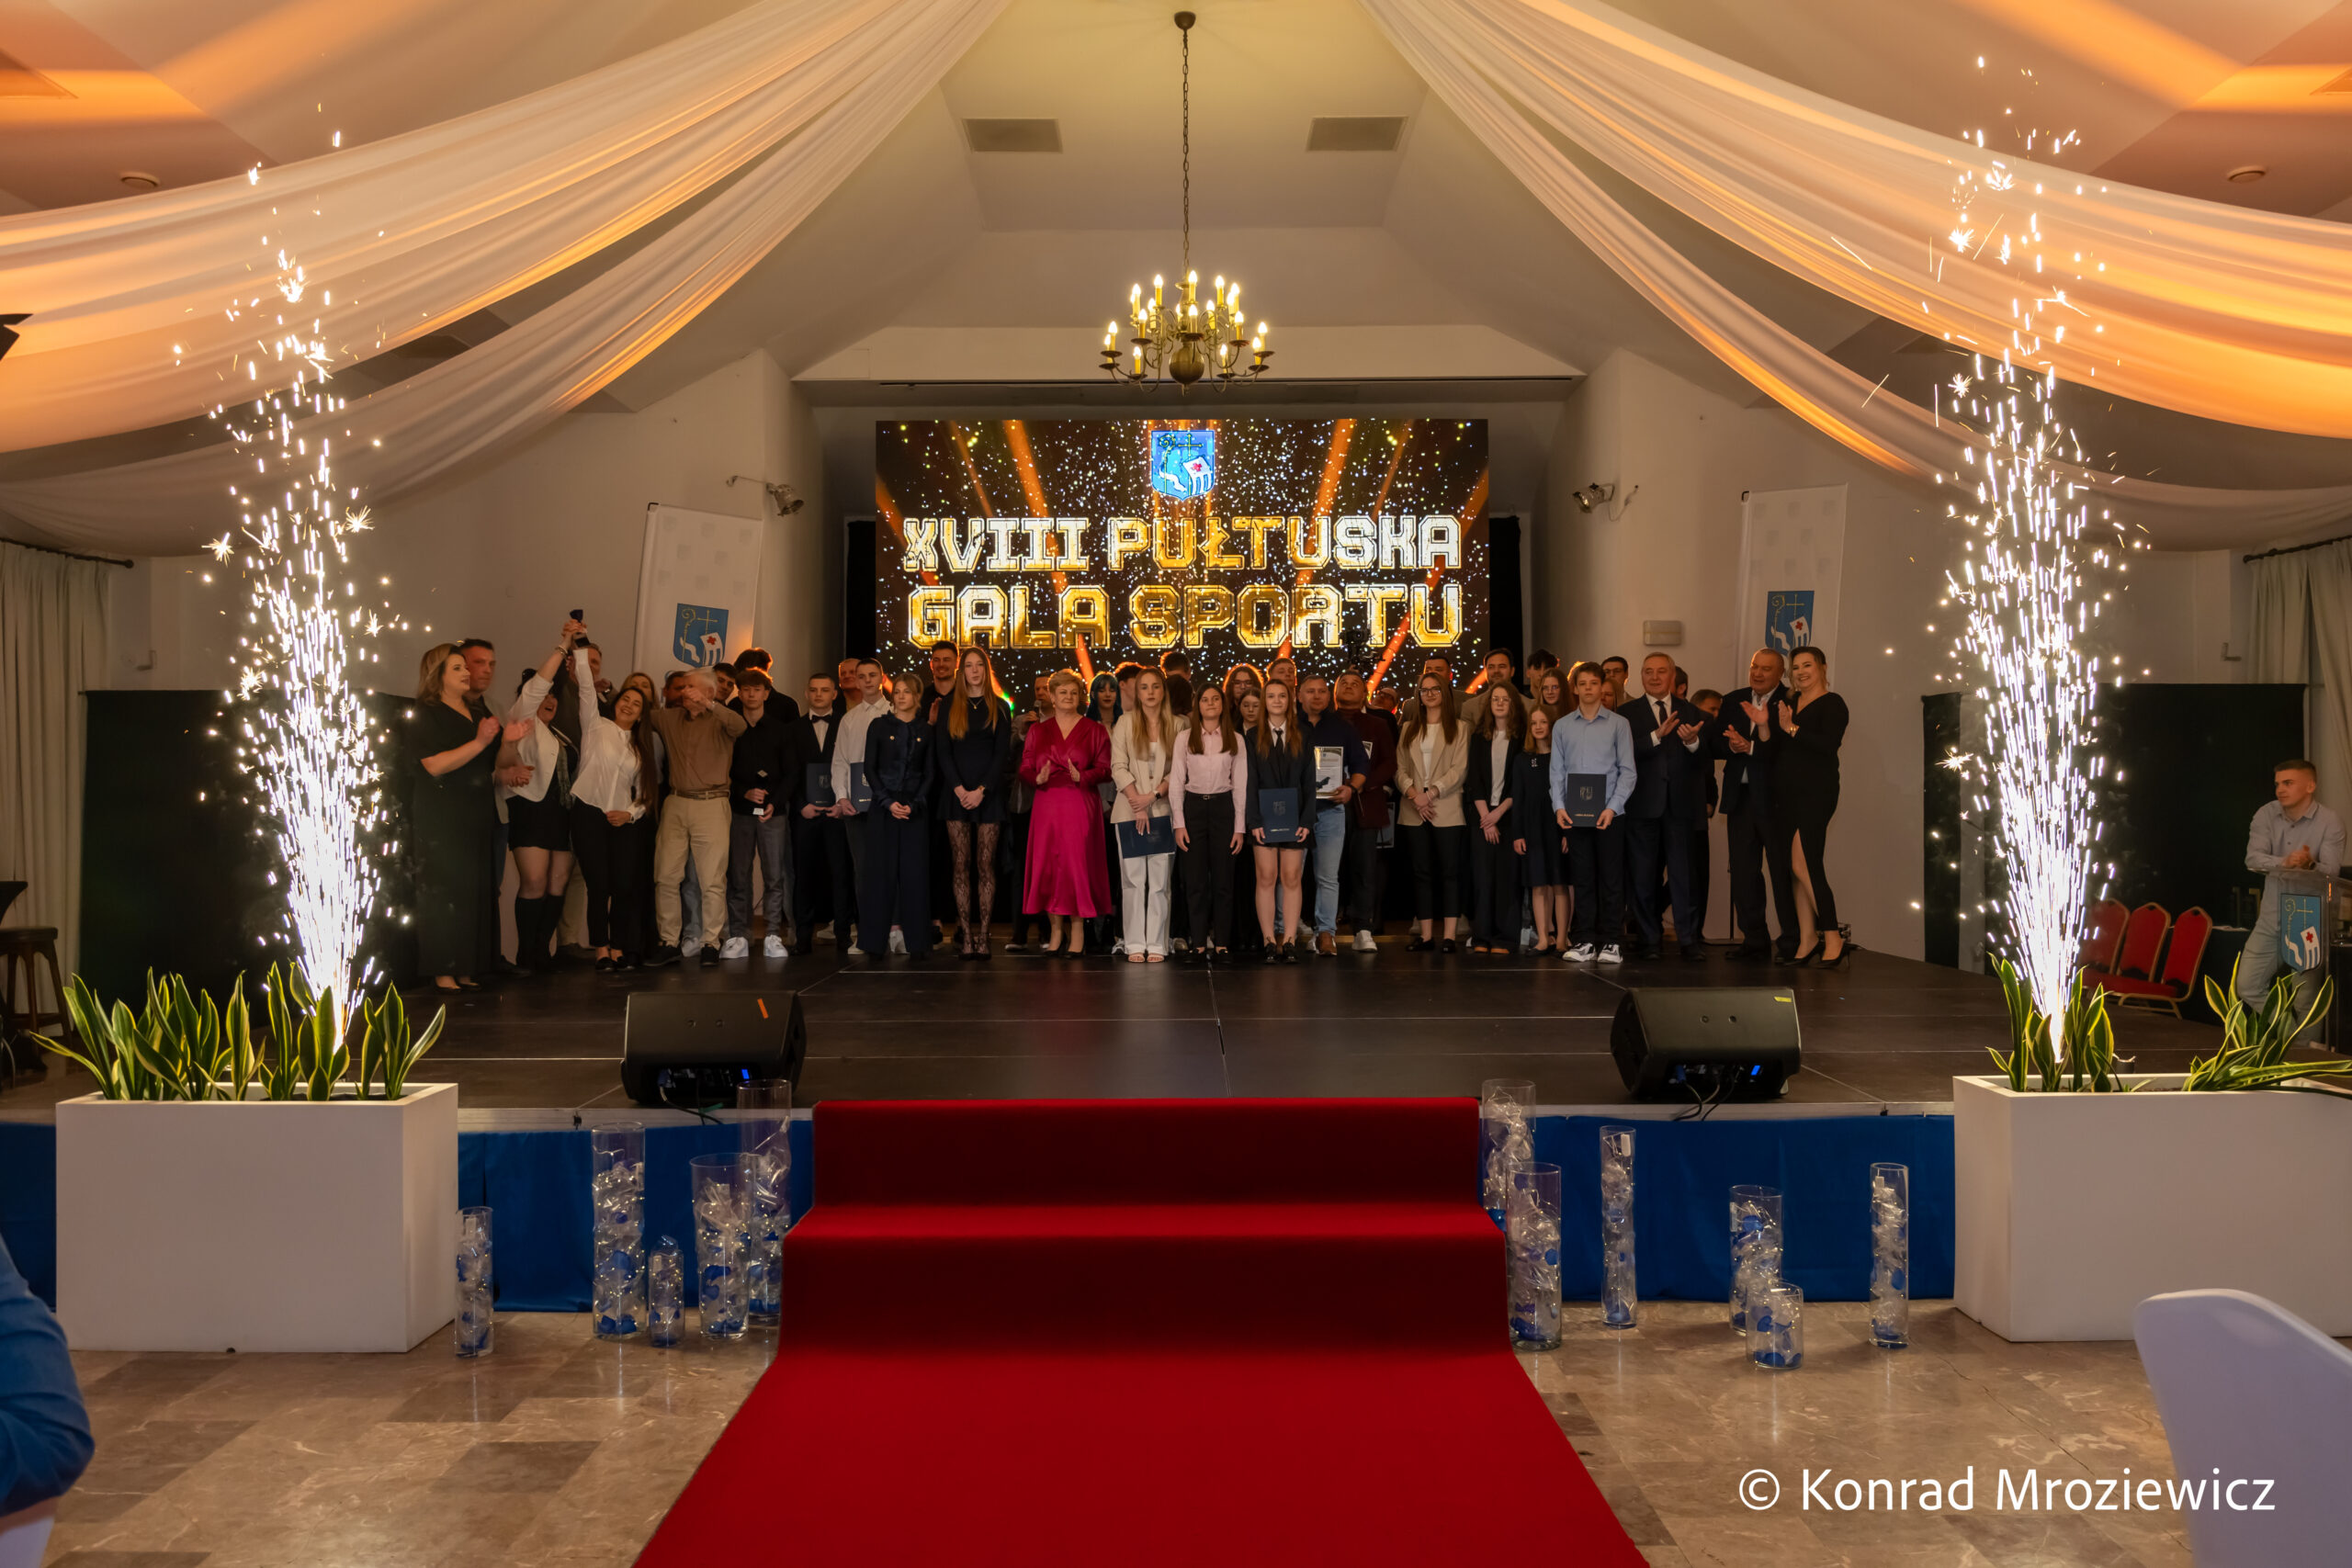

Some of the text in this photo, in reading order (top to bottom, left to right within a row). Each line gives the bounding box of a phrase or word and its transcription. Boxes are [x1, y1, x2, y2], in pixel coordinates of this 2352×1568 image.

[903, 515, 1462, 571] XVIII PUŁTUSKA
[909, 584, 1463, 649] GALA SPORTU
